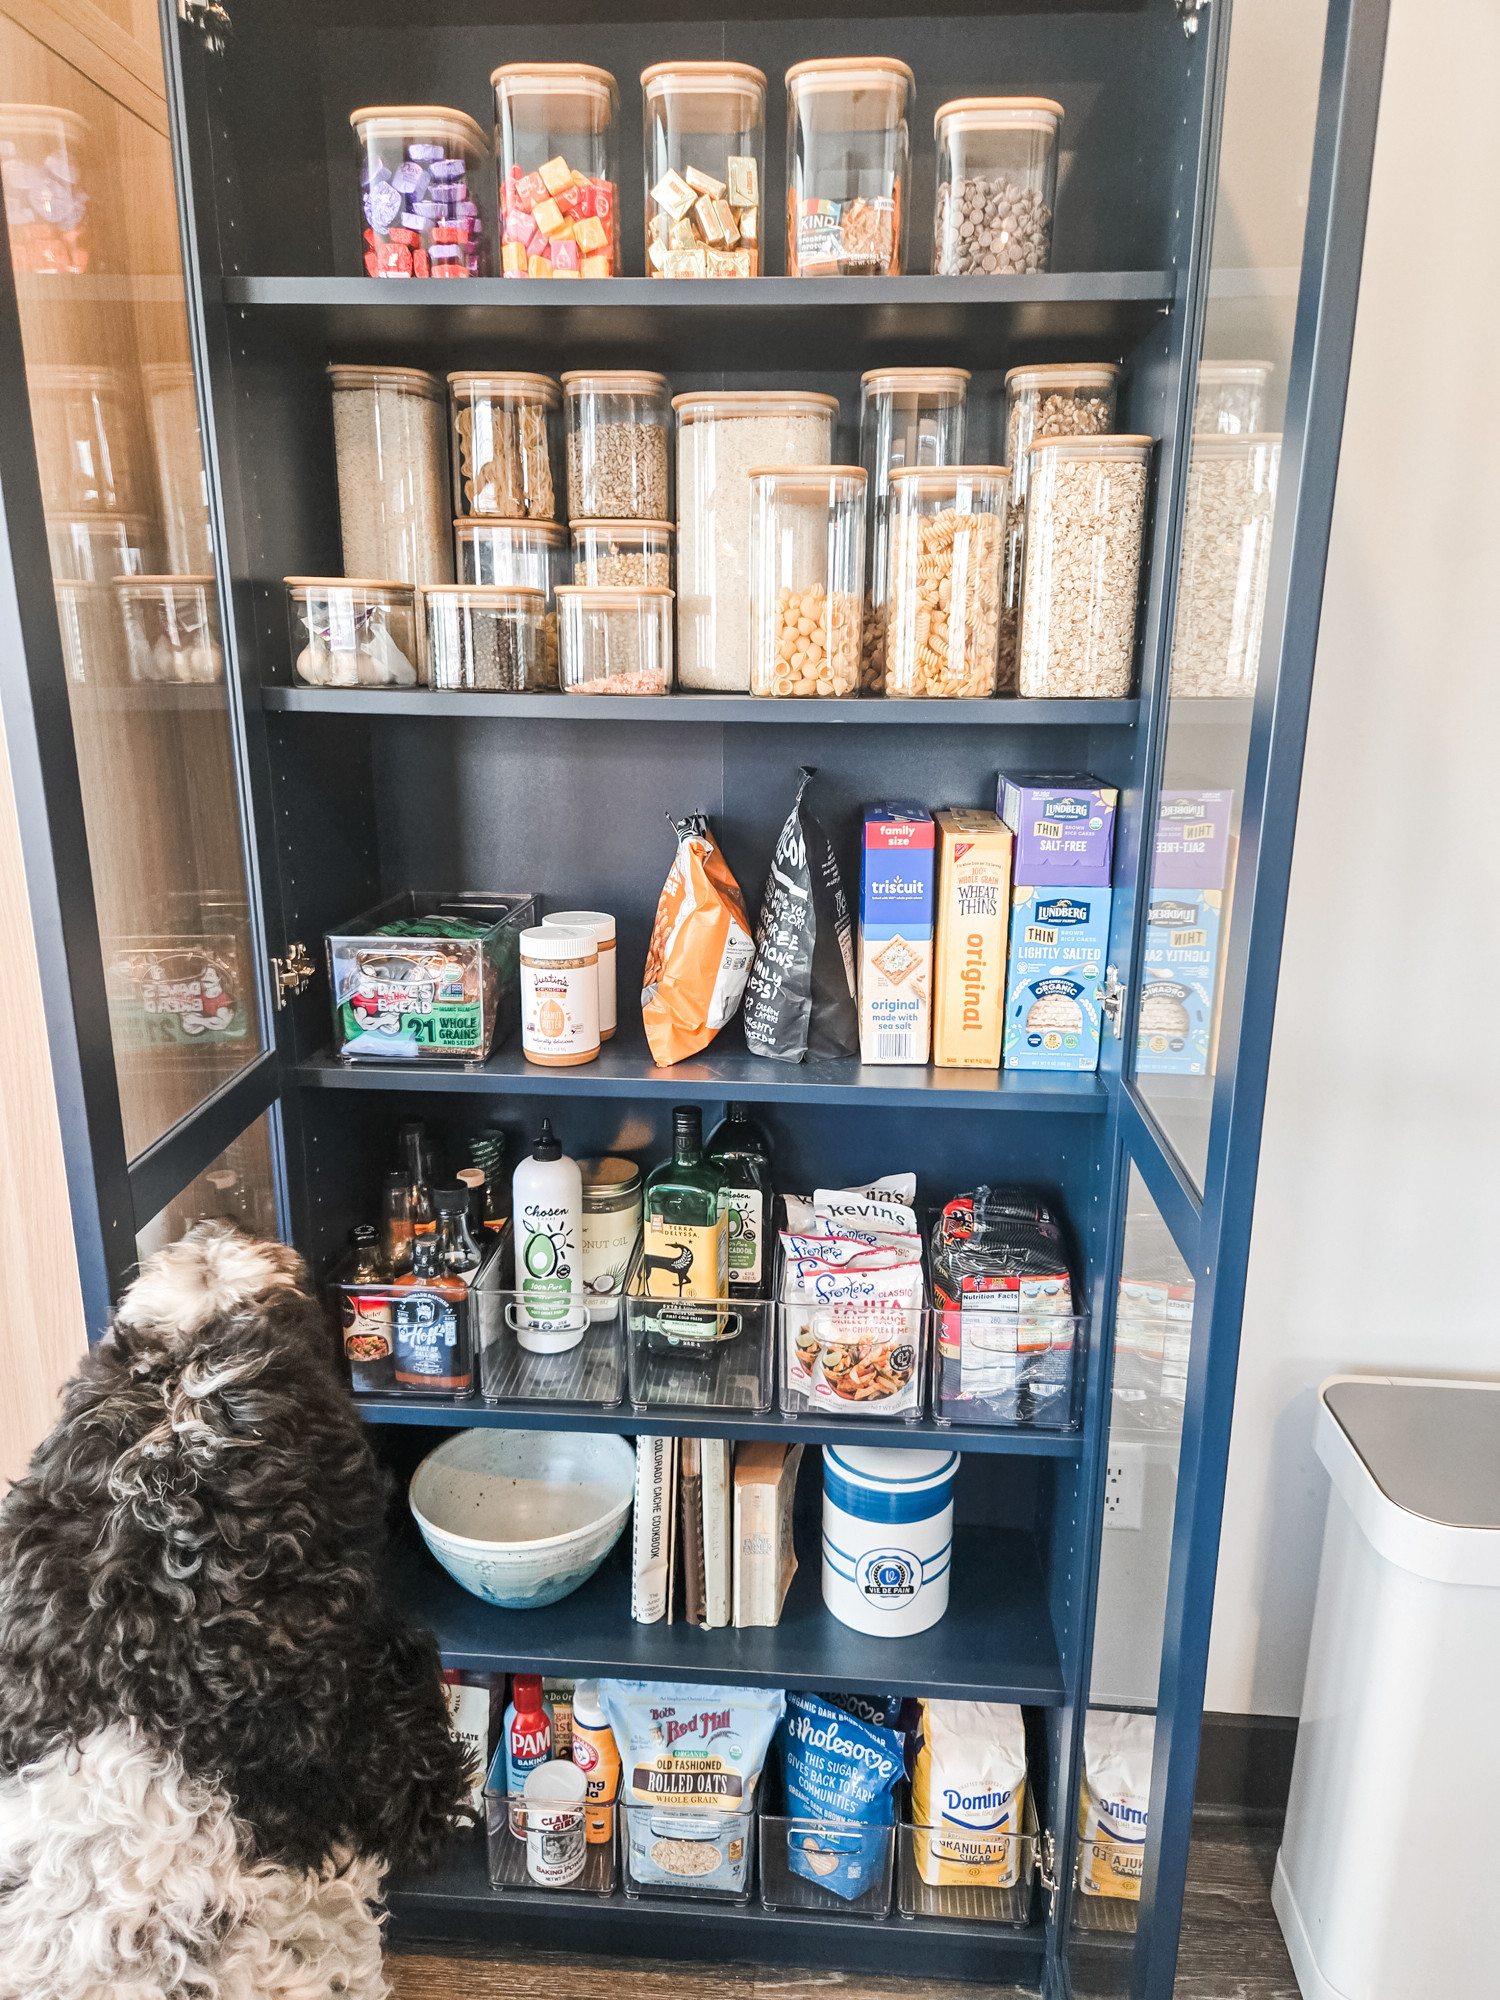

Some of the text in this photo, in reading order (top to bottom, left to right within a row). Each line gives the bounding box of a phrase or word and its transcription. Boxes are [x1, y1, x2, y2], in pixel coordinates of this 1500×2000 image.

[801, 214, 834, 231] KIND
[1044, 803, 1087, 816] LUNDBERG
[880, 825, 915, 838] family
[1037, 823, 1059, 837] THIN
[888, 836, 910, 846] size
[1040, 840, 1087, 852] SALT-FREE
[872, 880, 924, 894] triscuit
[958, 876, 999, 885] WHOLE GRAIN
[957, 885, 999, 900] WHEAT
[1037, 906, 1087, 920] LUNDBERG
[1028, 928, 1054, 943] THIN
[1018, 946, 1101, 960] LIGHTLY SALTED
[534, 974, 569, 987] Justin's
[961, 934, 987, 1031] original
[378, 982, 432, 998] DAVE'S
[1035, 983, 1077, 995] ORGANIC
[378, 998, 432, 1014] BREAD
[871, 999, 919, 1012] original
[440, 1017, 477, 1028] WHOLE
[872, 1013, 918, 1021] made with
[408, 1018, 437, 1042] 21
[895, 1022, 912, 1030] salt
[439, 1029, 478, 1040] GRAINS
[525, 1205, 569, 1217] Chosen
[613, 1237, 629, 1247] OIL
[878, 1289, 913, 1298] CLASSIC
[833, 1299, 904, 1316] FAJITA
[873, 1316, 907, 1326] SAUCE
[406, 1324, 446, 1348] Hoff's
[651, 1438, 663, 1559] COLORADO CACHE COOKBOOK
[787, 1691, 817, 1714] ORGANIC
[817, 1706, 837, 1721] DARK
[650, 1706, 676, 1721] Bob's
[666, 1713, 698, 1747] Red
[698, 1708, 731, 1739] Mill
[511, 1726, 551, 1756] PAM
[517, 1755, 547, 1766] BAKING
[674, 1750, 708, 1758] ORGANIC
[656, 1760, 722, 1770] OLD FASHIONED
[805, 1751, 859, 1780] THIS SUGAR
[647, 1772, 728, 1794] ROLLED OATS
[788, 1752, 875, 1803] GIVES BACK TO FARM
[656, 1795, 719, 1804] WHOLE GRAIN
[798, 1776, 857, 1813] COMMUNITIES
[943, 1789, 1011, 1810] Domino
[788, 1784, 810, 1804] ORGANIC
[810, 1800, 823, 1815] DARK
[823, 1809, 846, 1822] BROWN
[536, 1865, 563, 1875] BAKING
